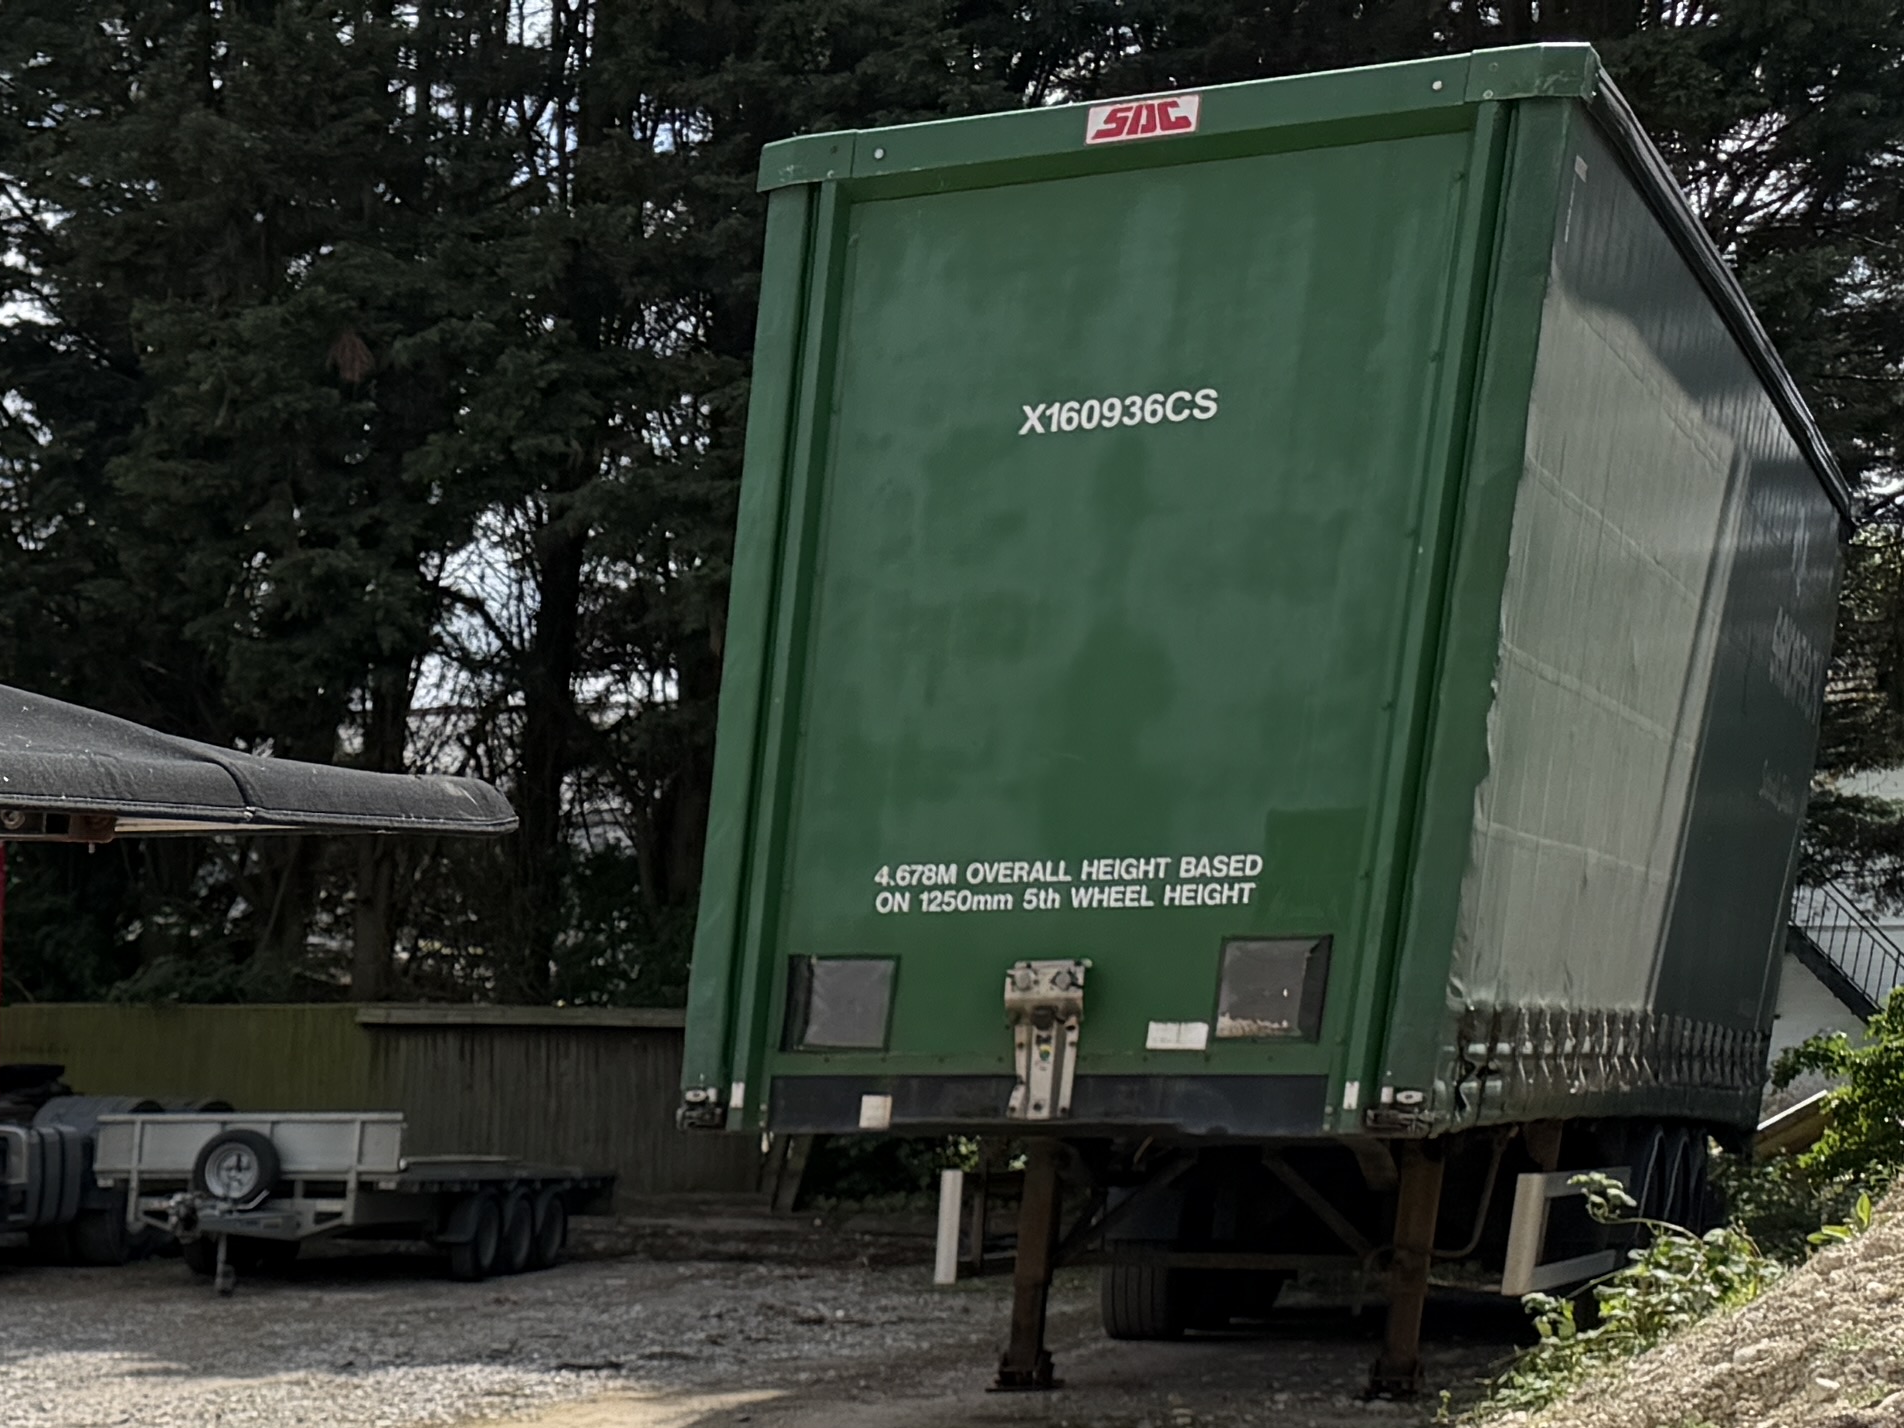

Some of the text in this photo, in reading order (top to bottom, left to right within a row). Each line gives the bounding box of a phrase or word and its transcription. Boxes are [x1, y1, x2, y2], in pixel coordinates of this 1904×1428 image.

[1091, 100, 1192, 140] SDC
[1018, 388, 1218, 435] X160936CS
[874, 854, 1263, 887] 4.678M OVERALL HEIGHT BASED
[875, 882, 1256, 914] ON 1250mm 5th WHEEL HEIGHT
